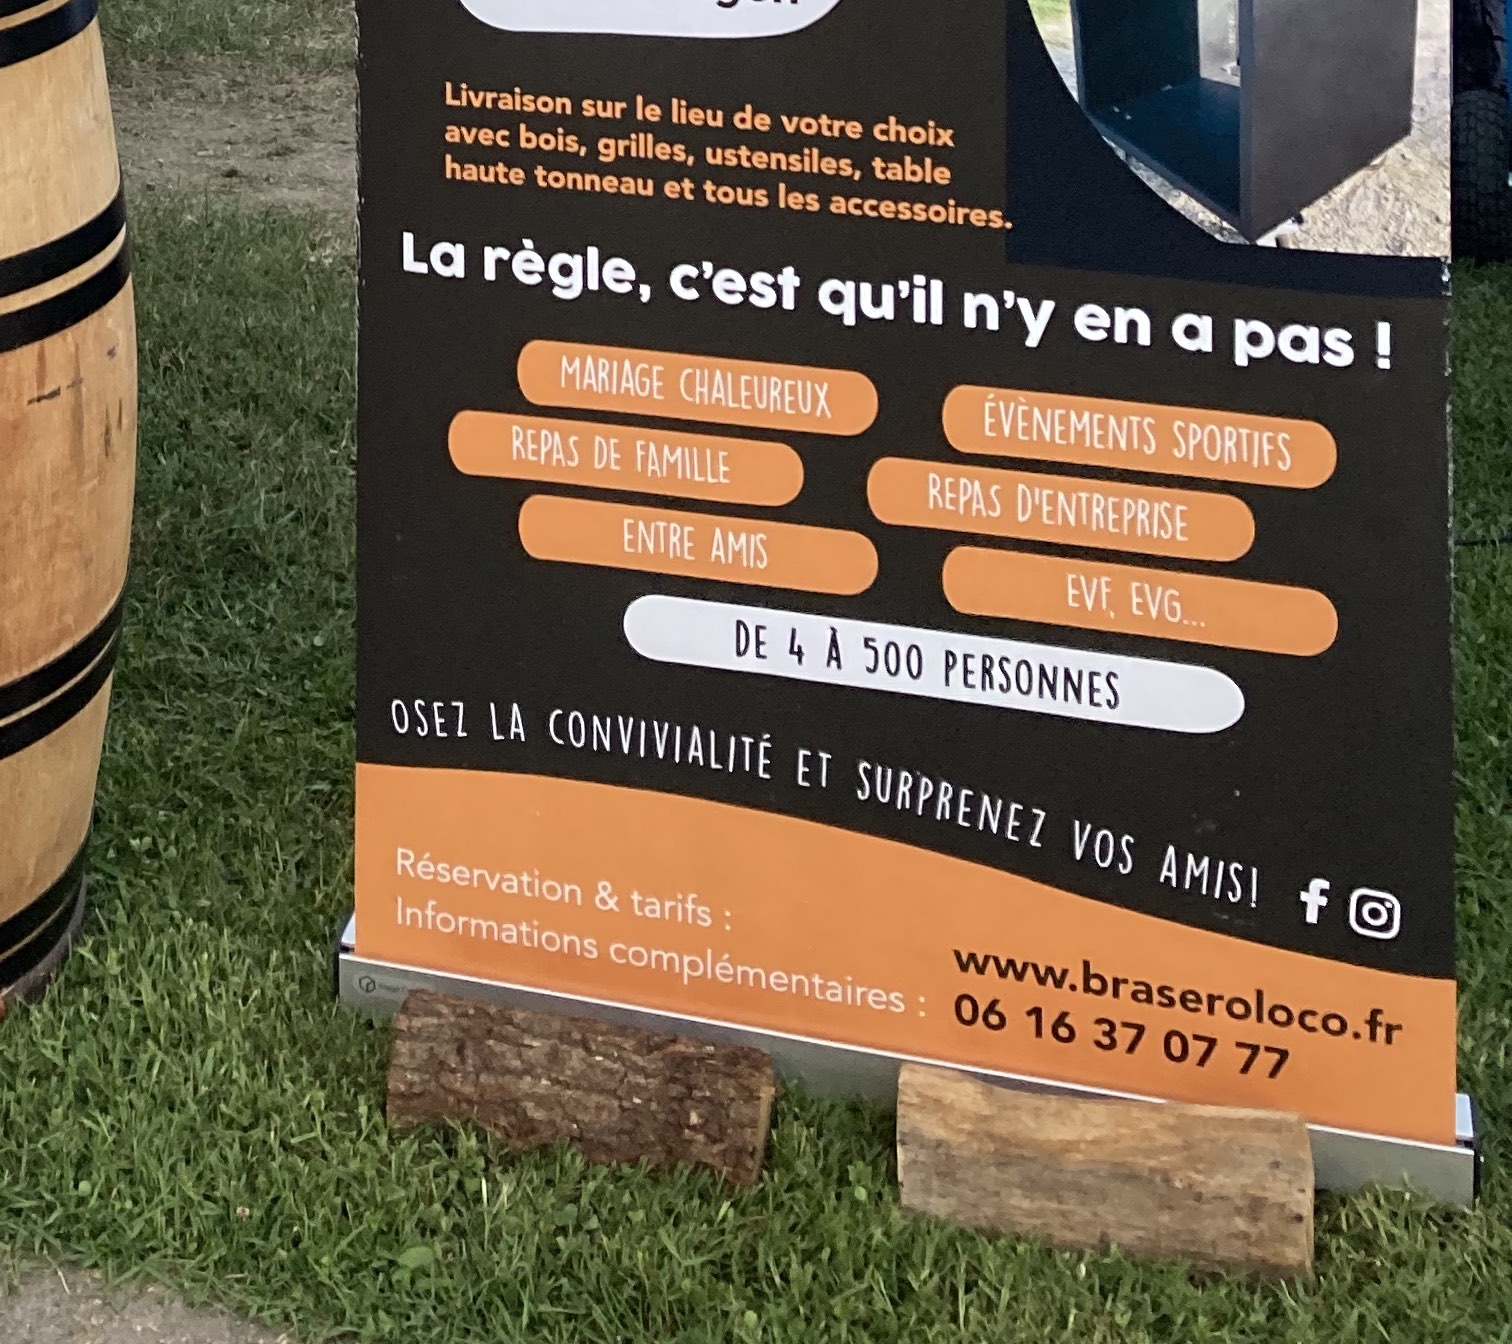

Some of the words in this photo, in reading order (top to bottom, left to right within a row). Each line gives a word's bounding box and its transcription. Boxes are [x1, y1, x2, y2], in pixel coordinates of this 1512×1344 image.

[445, 81, 572, 116] Livraison
[581, 96, 627, 119] sur
[636, 95, 661, 122] le
[671, 98, 724, 127] lieu
[733, 103, 770, 132] de
[781, 114, 863, 140] votre
[873, 114, 954, 148] choix
[445, 123, 511, 148] avec
[519, 123, 587, 157] bois,
[598, 129, 694, 166] grilles,
[706, 142, 861, 181] ustensiles,
[872, 153, 952, 186] table
[445, 155, 526, 187] haute
[534, 166, 654, 199] tonneau
[663, 176, 694, 202] et
[703, 179, 769, 209] tous
[778, 183, 820, 212] les
[829, 195, 1013, 230] accessoires.
[402, 231, 465, 279] La
[483, 238, 652, 303] règle,
[669, 260, 800, 312] c'est
[818, 274, 944, 327] qu'il
[963, 287, 1056, 348] n'y
[1074, 303, 1152, 347] en
[1171, 314, 1213, 353] a
[1234, 318, 1354, 369] pas
[1375, 321, 1391, 369] !
[560, 355, 665, 400] MARIAGE
[680, 367, 832, 420] CHALEUREUX
[512, 425, 580, 467] REPAS
[594, 439, 621, 472] DE
[635, 441, 731, 484] FAMILLE
[983, 393, 1156, 455] ÉVÈNEMENTS
[1173, 419, 1291, 472] SPORTIFS
[623, 518, 696, 561] ENTRE
[711, 528, 768, 570] AMIS
[928, 472, 1002, 519] REPAS
[1017, 483, 1189, 542] D'ENTREPRISE
[1066, 572, 1116, 619] EVF,
[1131, 586, 1206, 629] EVG...
[735, 618, 767, 660] DE
[787, 628, 804, 665] 4
[826, 626, 843, 670] À
[863, 637, 924, 681] 500
[944, 650, 1121, 710] PERSONNES
[391, 698, 467, 739] OSEZ
[490, 701, 526, 743] LA
[549, 707, 772, 779] CONVIVIALITÉ
[797, 749, 833, 788] ET
[857, 759, 1047, 847] SURPRENEZ
[1073, 819, 1135, 875] VOS
[1159, 845, 1259, 909] AMIS!
[396, 847, 582, 906] Réservation
[594, 881, 620, 911] &
[630, 890, 712, 927] tarifs
[396, 896, 599, 960] Informations
[608, 939, 906, 1014] complémentaires
[953, 949, 1403, 1046] www.braseroloco.fr
[954, 992, 1007, 1031] 06
[1026, 1006, 1076, 1045] 16
[1093, 1017, 1146, 1055] 37
[1163, 1030, 1217, 1069] 07
[1235, 1041, 1290, 1080] 77
